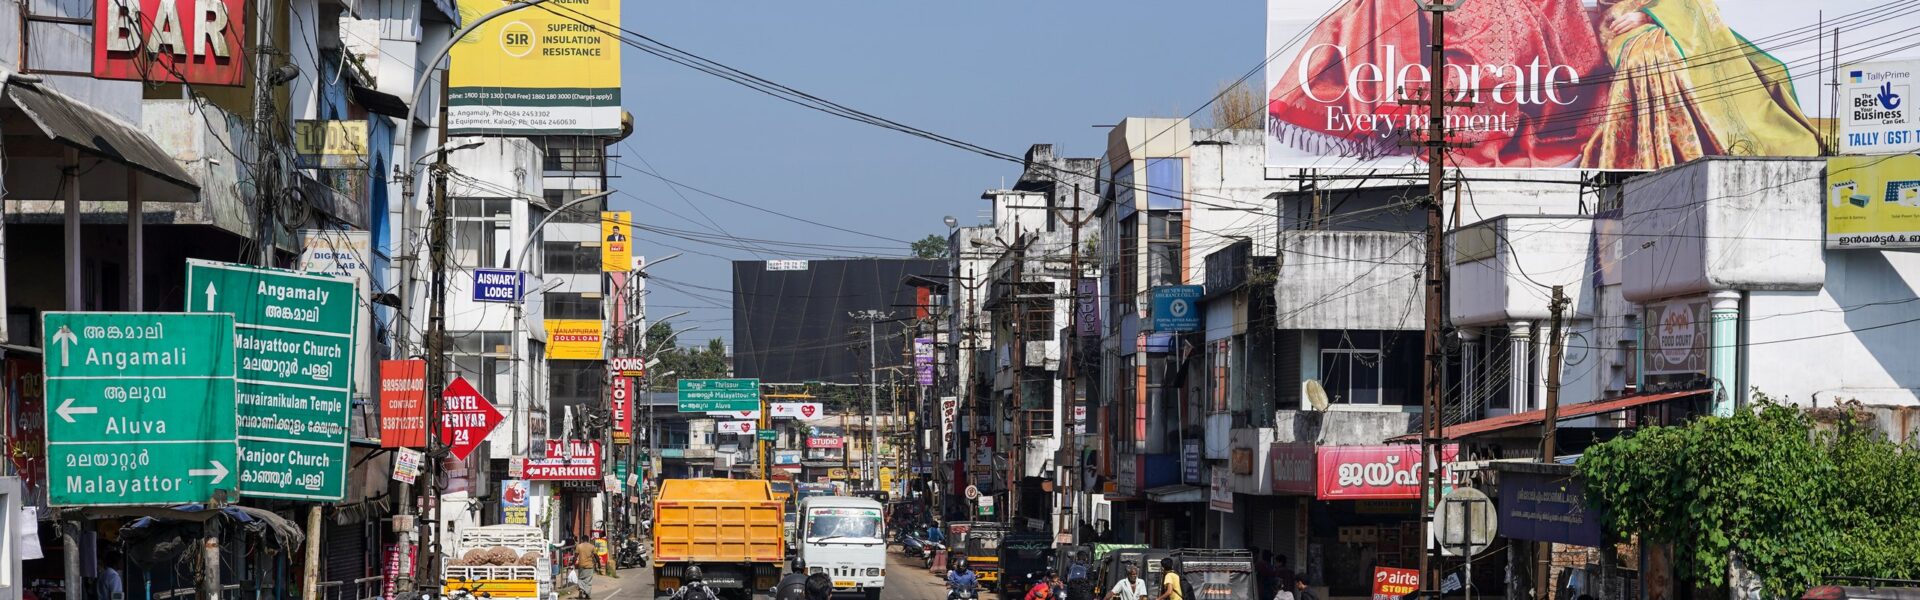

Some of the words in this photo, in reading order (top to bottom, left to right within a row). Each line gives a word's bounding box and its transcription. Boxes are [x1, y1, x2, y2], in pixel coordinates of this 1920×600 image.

[107, 0, 229, 59] BAR
[548, 24, 596, 32] SUPERIOR
[506, 34, 528, 44] SIR
[542, 36, 600, 44] INSULATION
[542, 48, 600, 56] RESISTANCE
[1866, 71, 1910, 81] TallyPrime
[1854, 97, 1878, 107] Best
[1325, 105, 1396, 135] Every
[1398, 110, 1515, 134] mment.
[1854, 110, 1902, 120] Business
[1848, 132, 1879, 146] TALLY
[1884, 130, 1912, 144] (GST)
[314, 252, 352, 260] DIGITAL
[477, 273, 520, 285] AISWARY
[257, 280, 330, 305] Angamaly
[485, 286, 513, 298] LODGE
[84, 322, 163, 339] അങ്കമാലി
[236, 334, 300, 354] Malayattoor
[303, 340, 341, 358] Church
[85, 348, 186, 369] Angamali
[104, 386, 166, 403] ആലുവ
[237, 390, 307, 410] iruvairanikulam
[310, 396, 342, 415] Temple
[389, 400, 417, 408] CONTACT
[444, 396, 478, 410] HOTEL
[614, 379, 626, 430] HOTEL
[105, 417, 166, 434] Aluva
[455, 430, 469, 441] 24
[238, 446, 285, 466] Kanjoor
[288, 450, 329, 467] Church
[542, 467, 596, 476] PARKING
[66, 475, 182, 496] Malayattor
[1388, 571, 1420, 585] airtel
[1382, 585, 1414, 594] STORE
